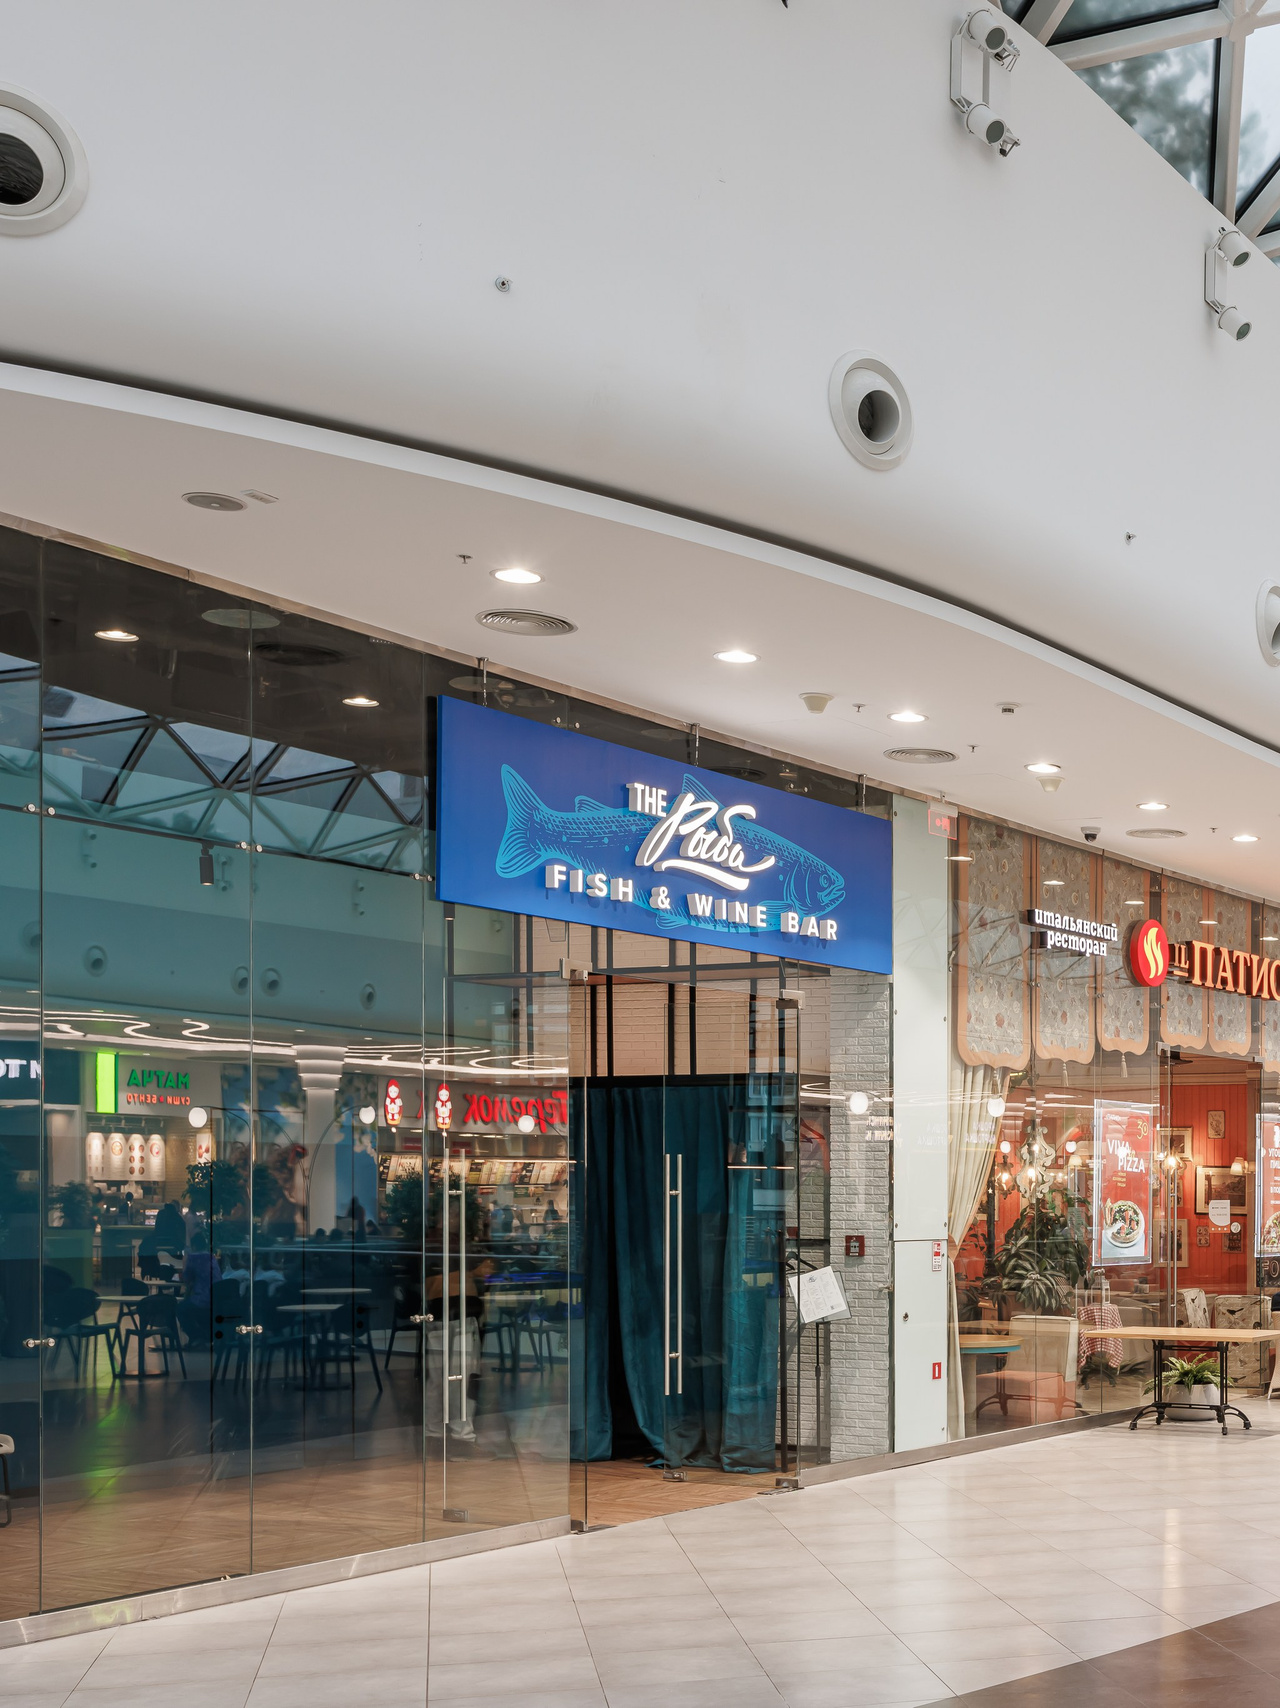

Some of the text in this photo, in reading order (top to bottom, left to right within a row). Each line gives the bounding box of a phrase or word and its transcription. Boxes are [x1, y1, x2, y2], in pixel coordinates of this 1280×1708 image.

[628, 782, 667, 818] THE
[545, 865, 838, 941] FISH & WINE BAR
[1034, 908, 1118, 941] итальянский
[1046, 930, 1107, 957] ресторан
[1117, 1157, 1146, 1174] PIZZA
